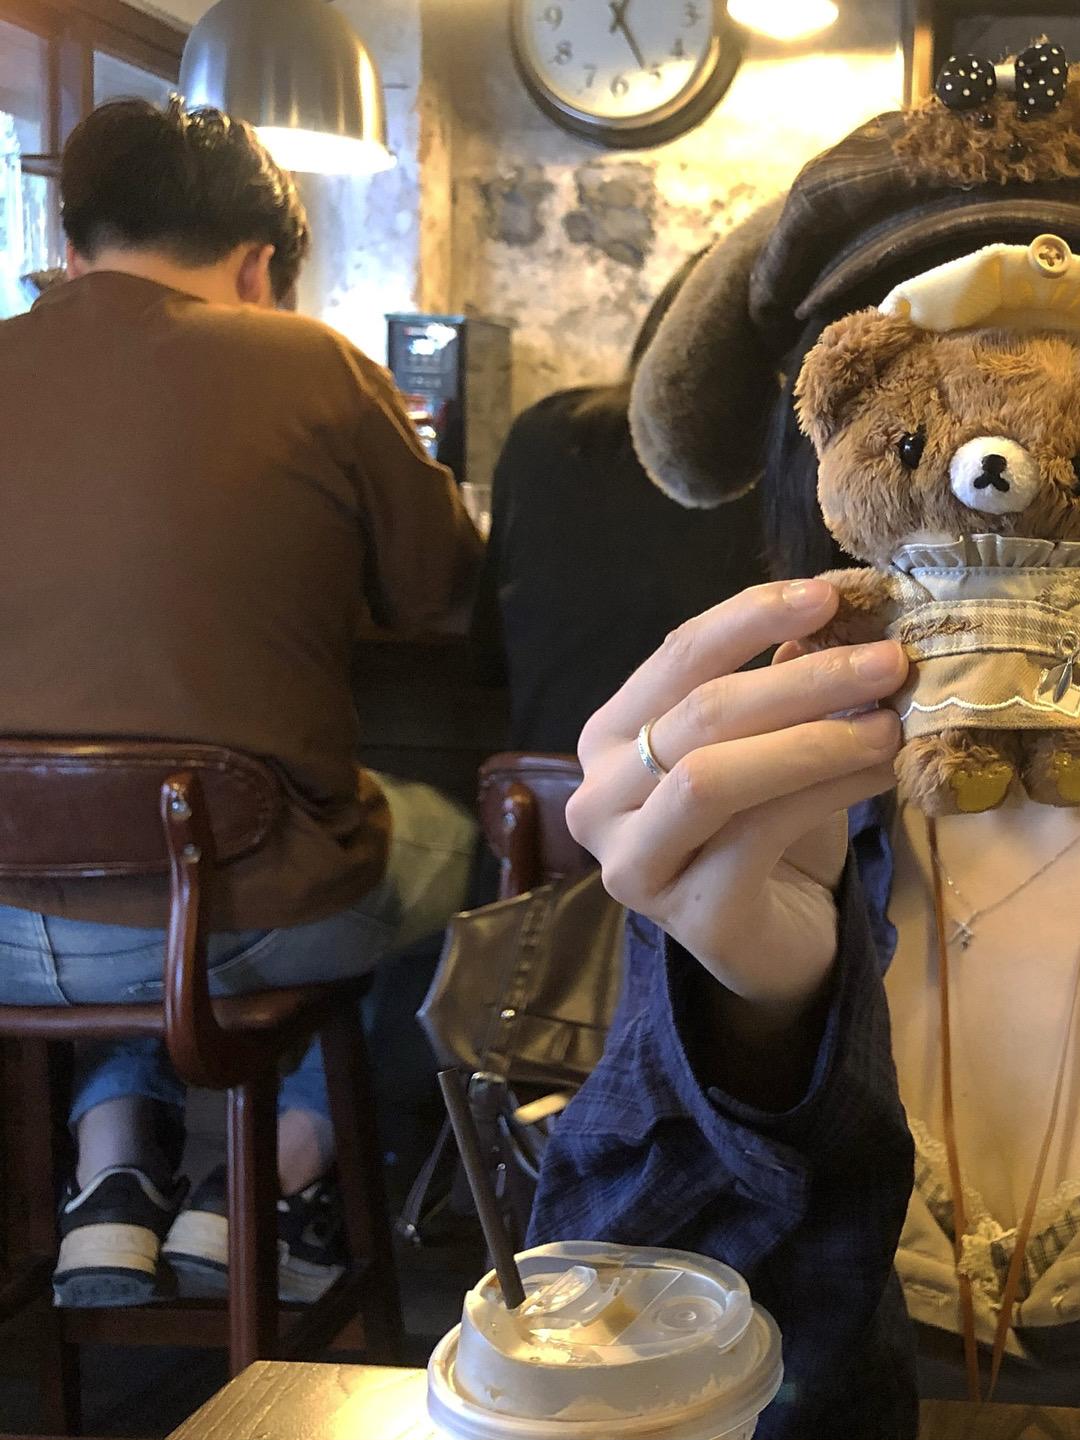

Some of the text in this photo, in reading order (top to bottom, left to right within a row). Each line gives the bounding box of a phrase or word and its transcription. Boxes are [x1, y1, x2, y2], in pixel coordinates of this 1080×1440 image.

[543, 5, 563, 31] 9
[555, 40, 572, 66] 8
[582, 63, 598, 88] 7
